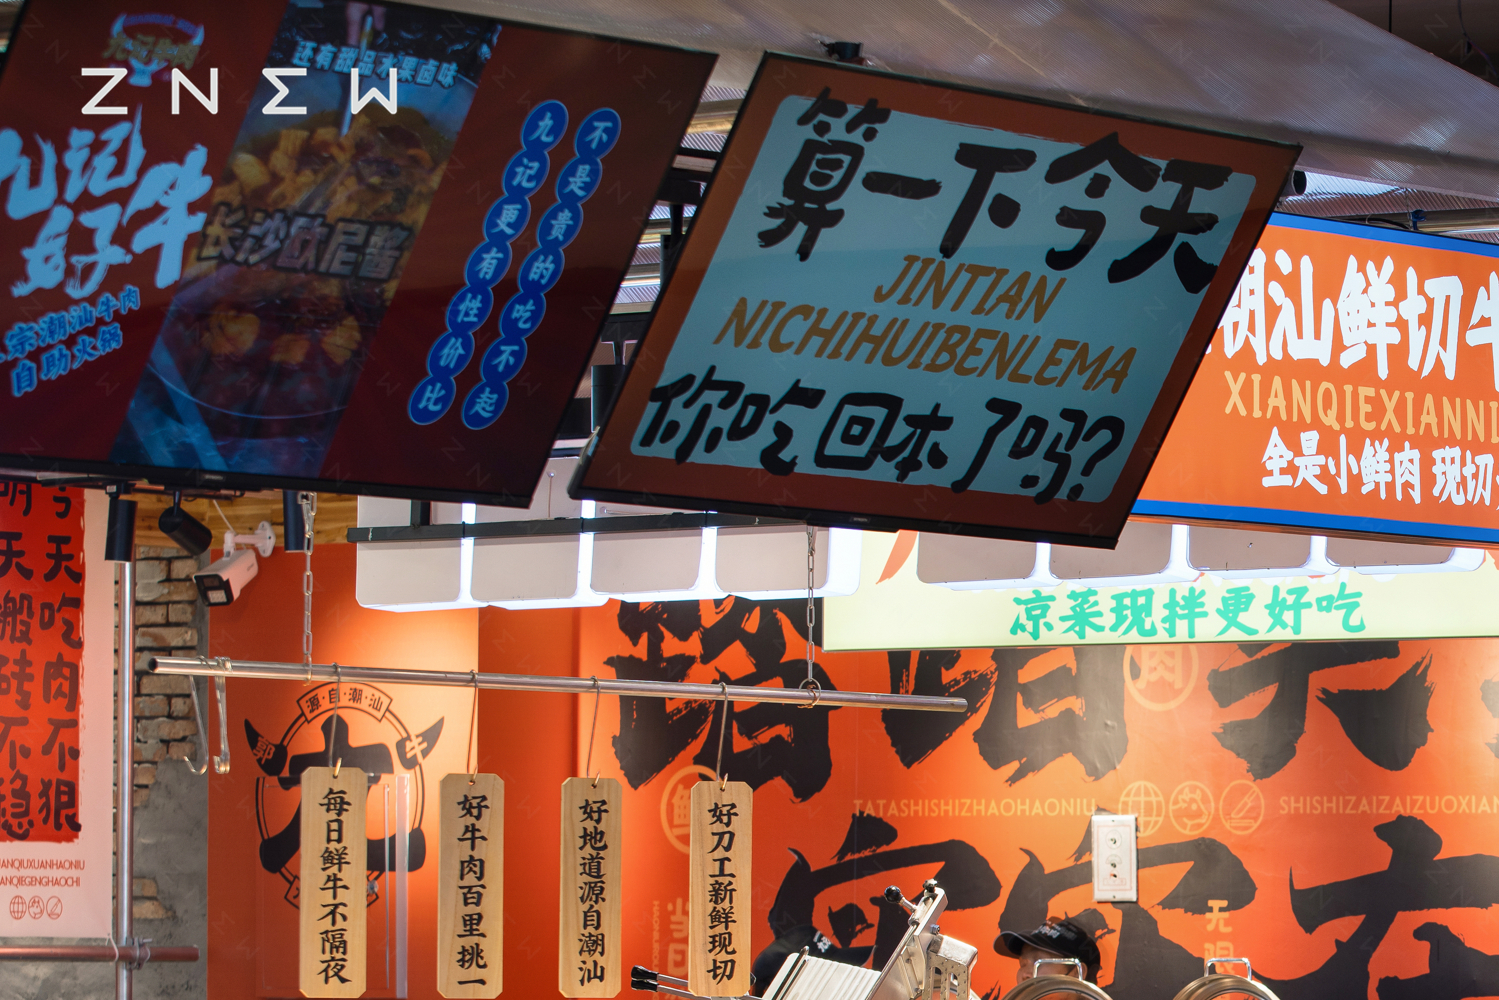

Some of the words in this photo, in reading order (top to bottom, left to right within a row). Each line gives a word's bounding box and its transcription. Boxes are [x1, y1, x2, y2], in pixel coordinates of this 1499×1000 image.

[758, 86, 1232, 294] 算一下今天
[0, 284, 141, 363] 宗潮汕牛肉
[417, 112, 554, 412] 九记更有性价比
[468, 121, 613, 419] 不是贵的吃不起
[874, 255, 1067, 324] JINTIAN
[11, 322, 123, 397] 自助火锅
[712, 297, 1138, 395] NICHIHUIBENLEMA
[1261, 426, 1421, 504] 全是小鲜肉
[1008, 580, 1367, 640] 凉菜现拌更好吃
[405, 734, 429, 765] 牛
[316, 787, 352, 985] 每日鲜牛不隔夜
[456, 794, 490, 987] 好牛肉百里挑一
[577, 798, 609, 987] 好地道源自潮汕
[706, 801, 739, 985] 好刀工新鲜现切
